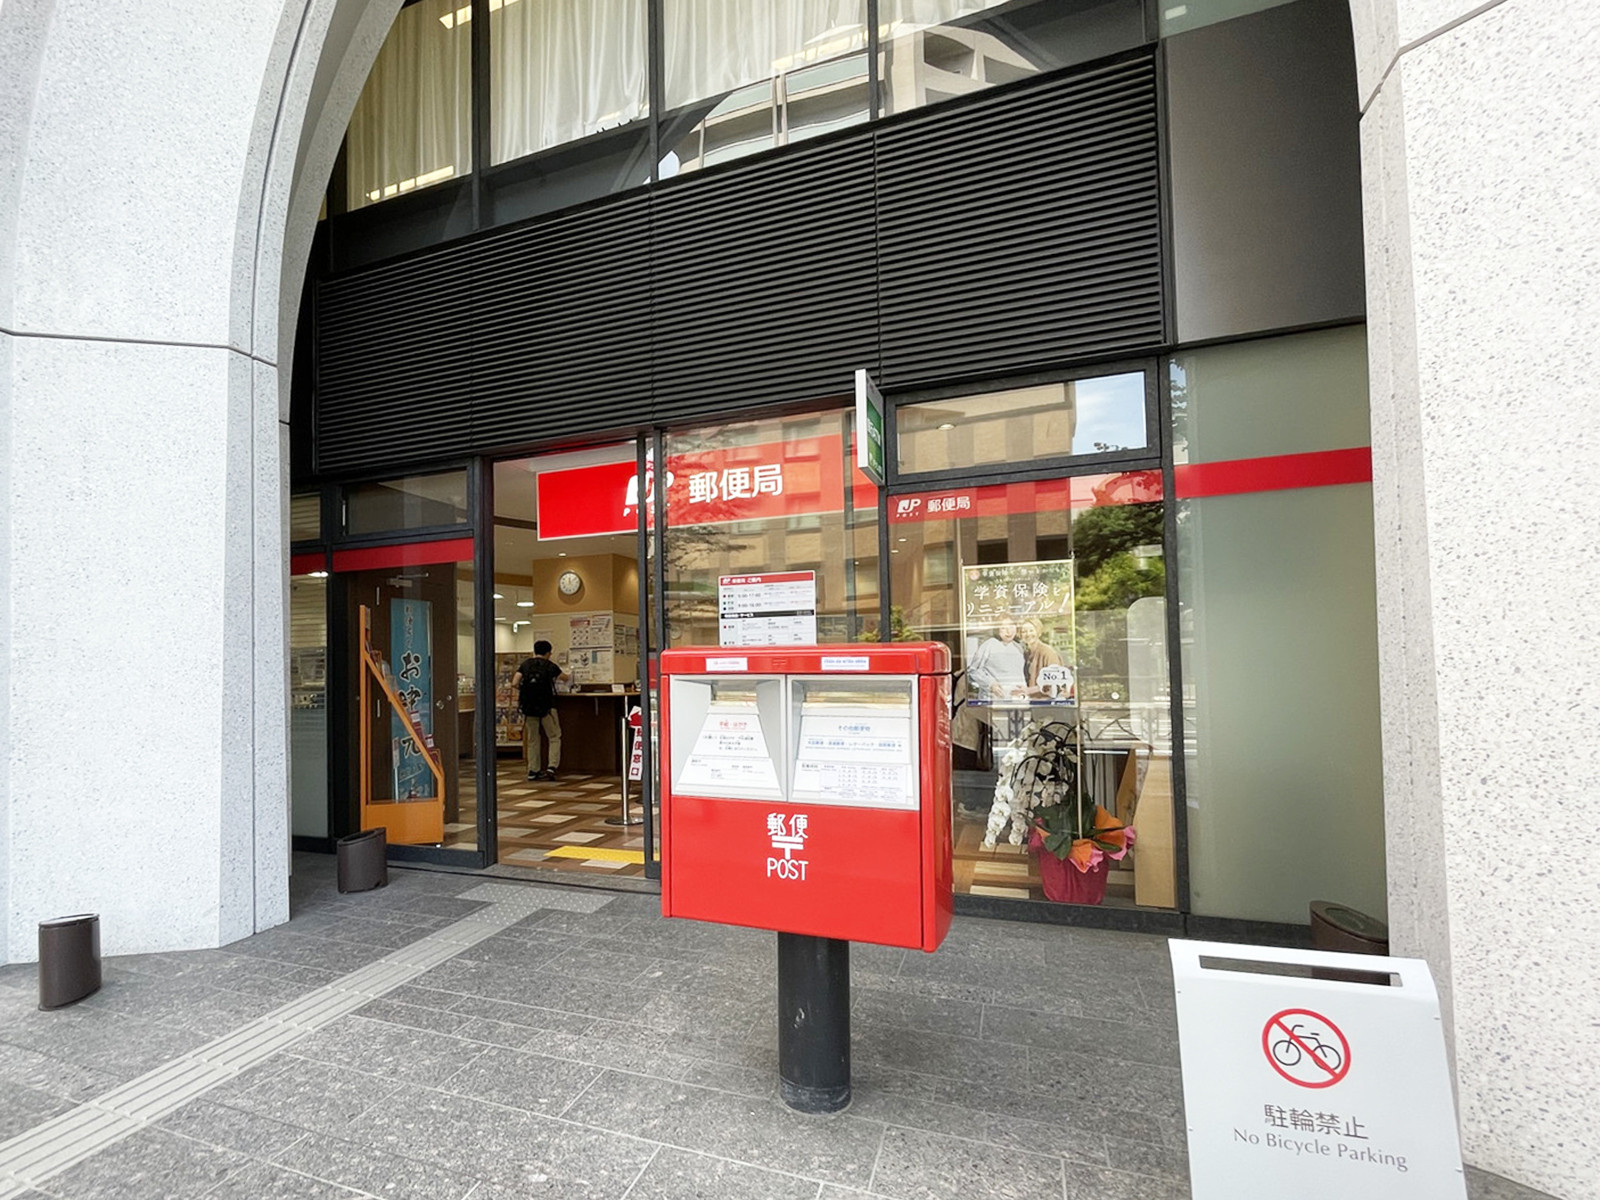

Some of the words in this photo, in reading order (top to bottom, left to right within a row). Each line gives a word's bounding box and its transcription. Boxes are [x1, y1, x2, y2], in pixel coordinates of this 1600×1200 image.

[688, 463, 784, 504] 郵便局
[926, 495, 971, 513] 郵便局
[973, 582, 1062, 601] 学資保険を
[767, 812, 809, 839] 郵便
[766, 857, 809, 881] POST
[1263, 1103, 1369, 1141] 駐輪禁止
[1233, 1126, 1261, 1146] No
[1265, 1132, 1332, 1157] Bicycle
[1337, 1142, 1409, 1173] Parking
